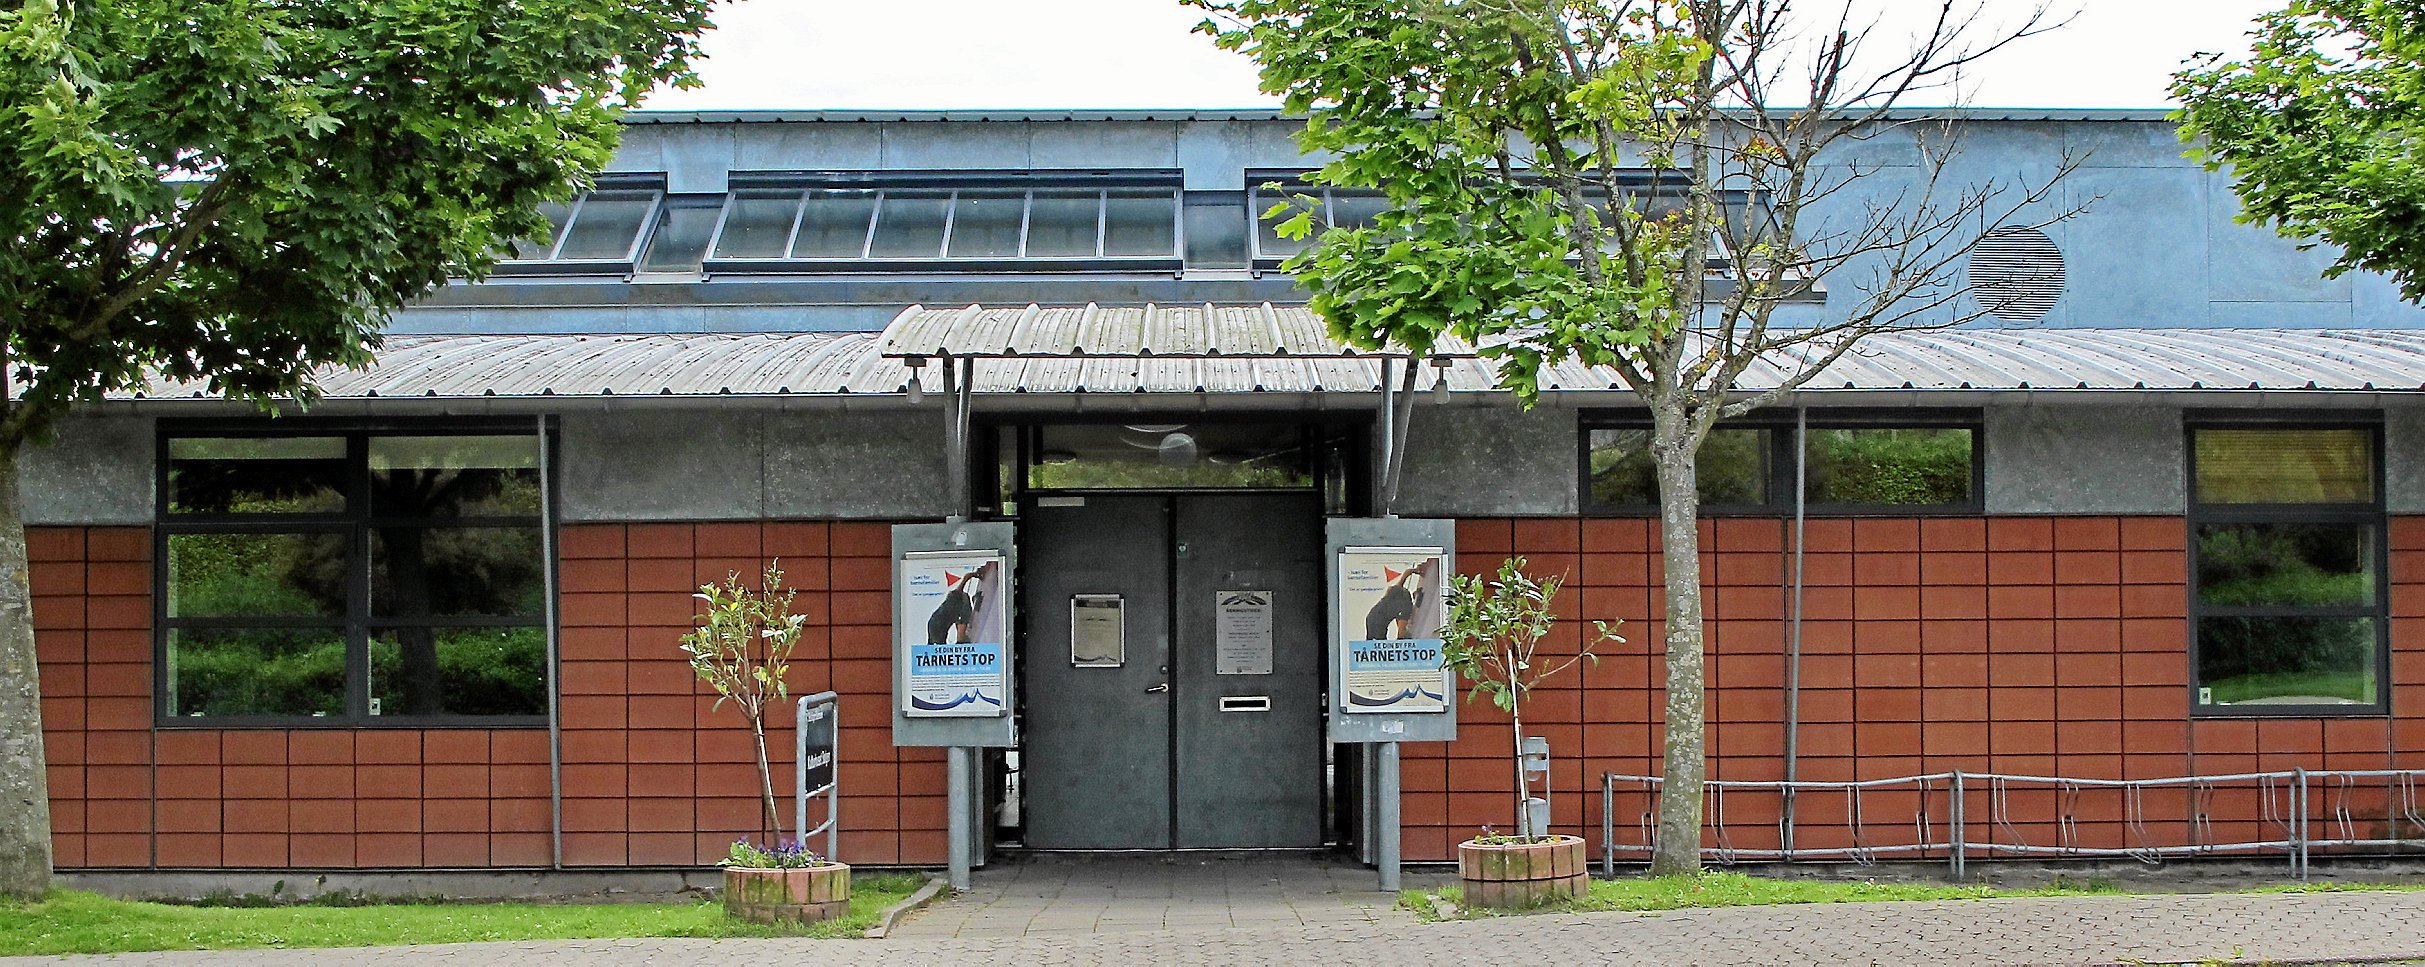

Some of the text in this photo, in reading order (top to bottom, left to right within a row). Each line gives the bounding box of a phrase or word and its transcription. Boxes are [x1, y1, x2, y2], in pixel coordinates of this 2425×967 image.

[916, 652, 996, 667] TÅRNETS TOP
[1353, 647, 1436, 663] TÅRNETS TOP
